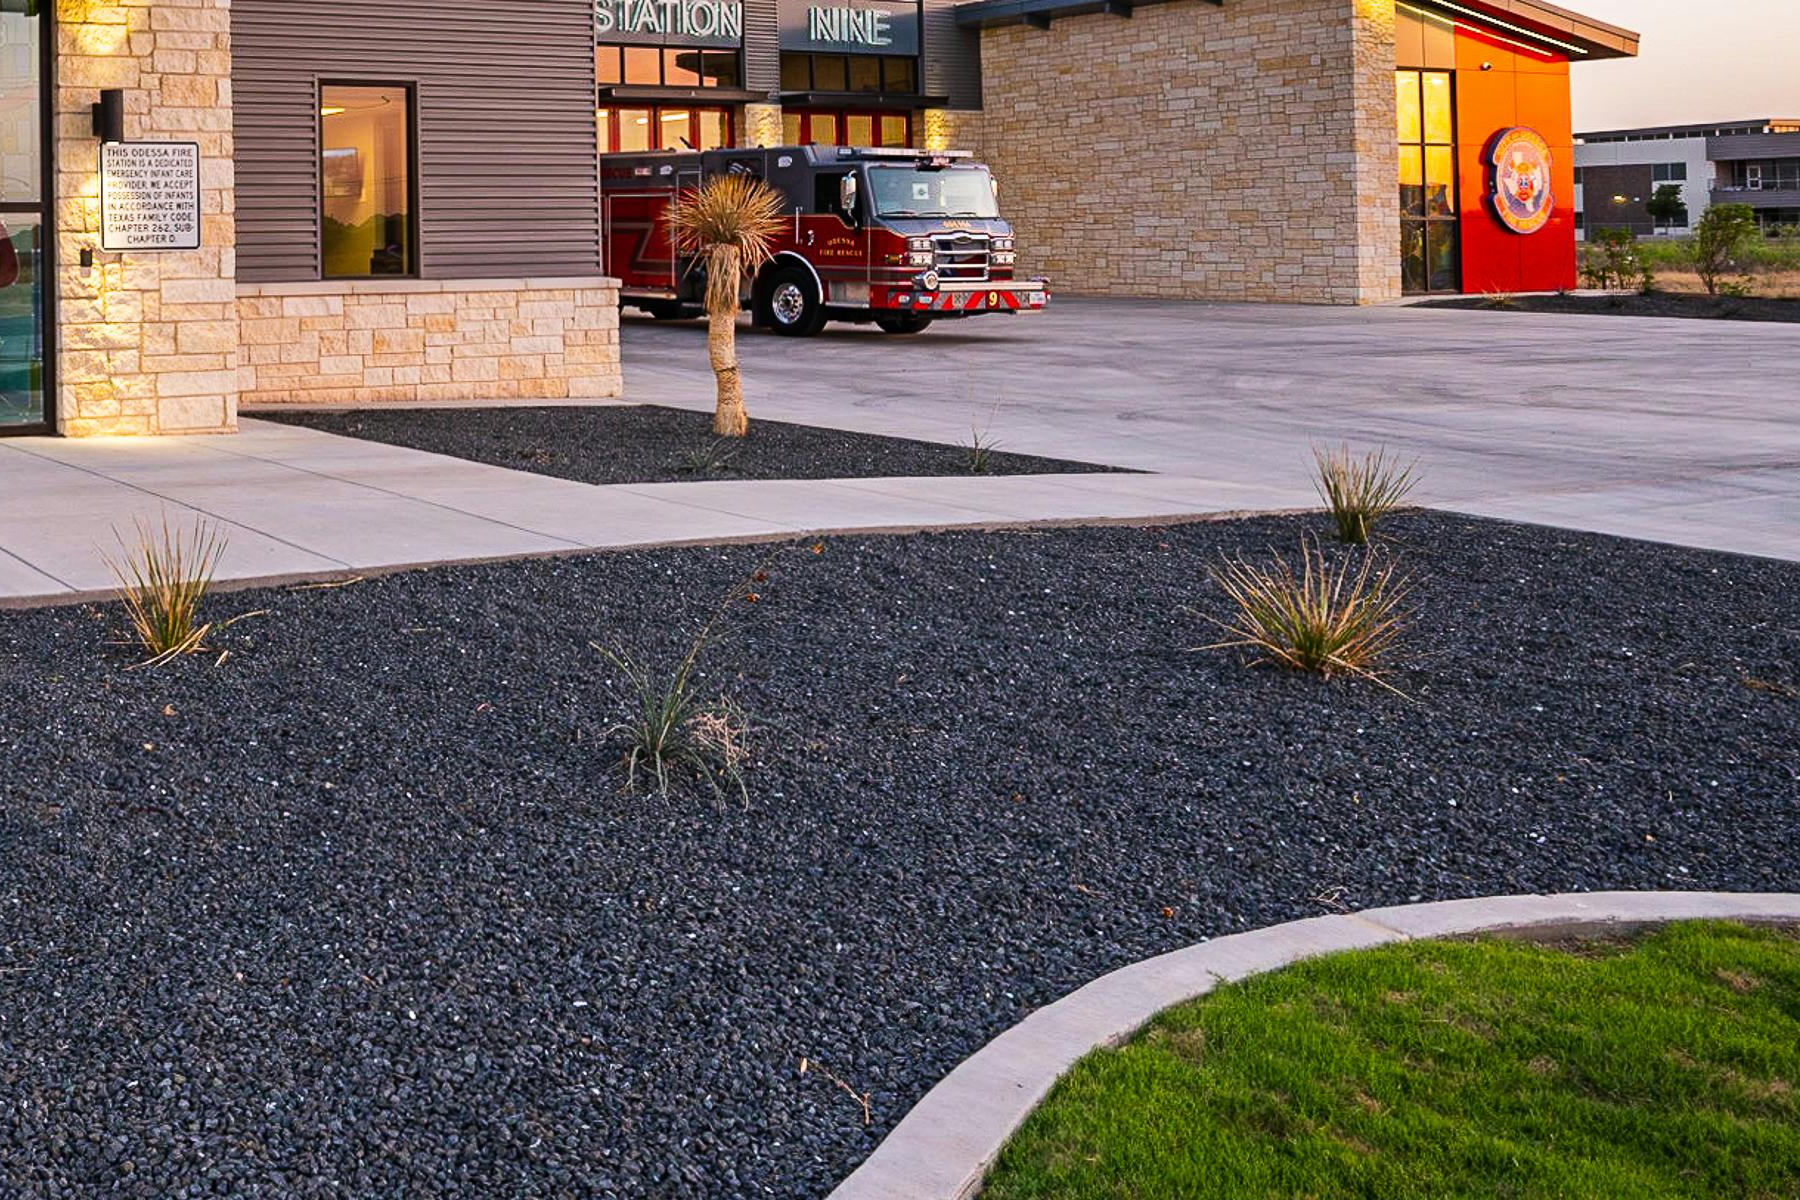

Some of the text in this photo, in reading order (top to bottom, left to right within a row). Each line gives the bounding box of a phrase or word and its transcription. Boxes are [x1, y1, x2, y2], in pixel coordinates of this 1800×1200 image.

[809, 6, 892, 45] NINE
[107, 148, 192, 157] THIS ODESSA FIRE
[107, 159, 193, 168] STATION IS A DEDICATED
[107, 169, 193, 178] EMERGENCY INFANT CARE
[150, 180, 161, 189] WE
[163, 180, 193, 189] ACCEPT
[108, 191, 193, 200] POSSESSION OF INFANTS
[108, 202, 194, 211] IN ACCORDANCE WITH
[109, 212, 134, 222] TEXAS
[137, 212, 168, 222] FAMILY
[108, 223, 149, 233] CHAPTER
[127, 234, 167, 244] CHAPTER
[989, 291, 998, 306] 9
